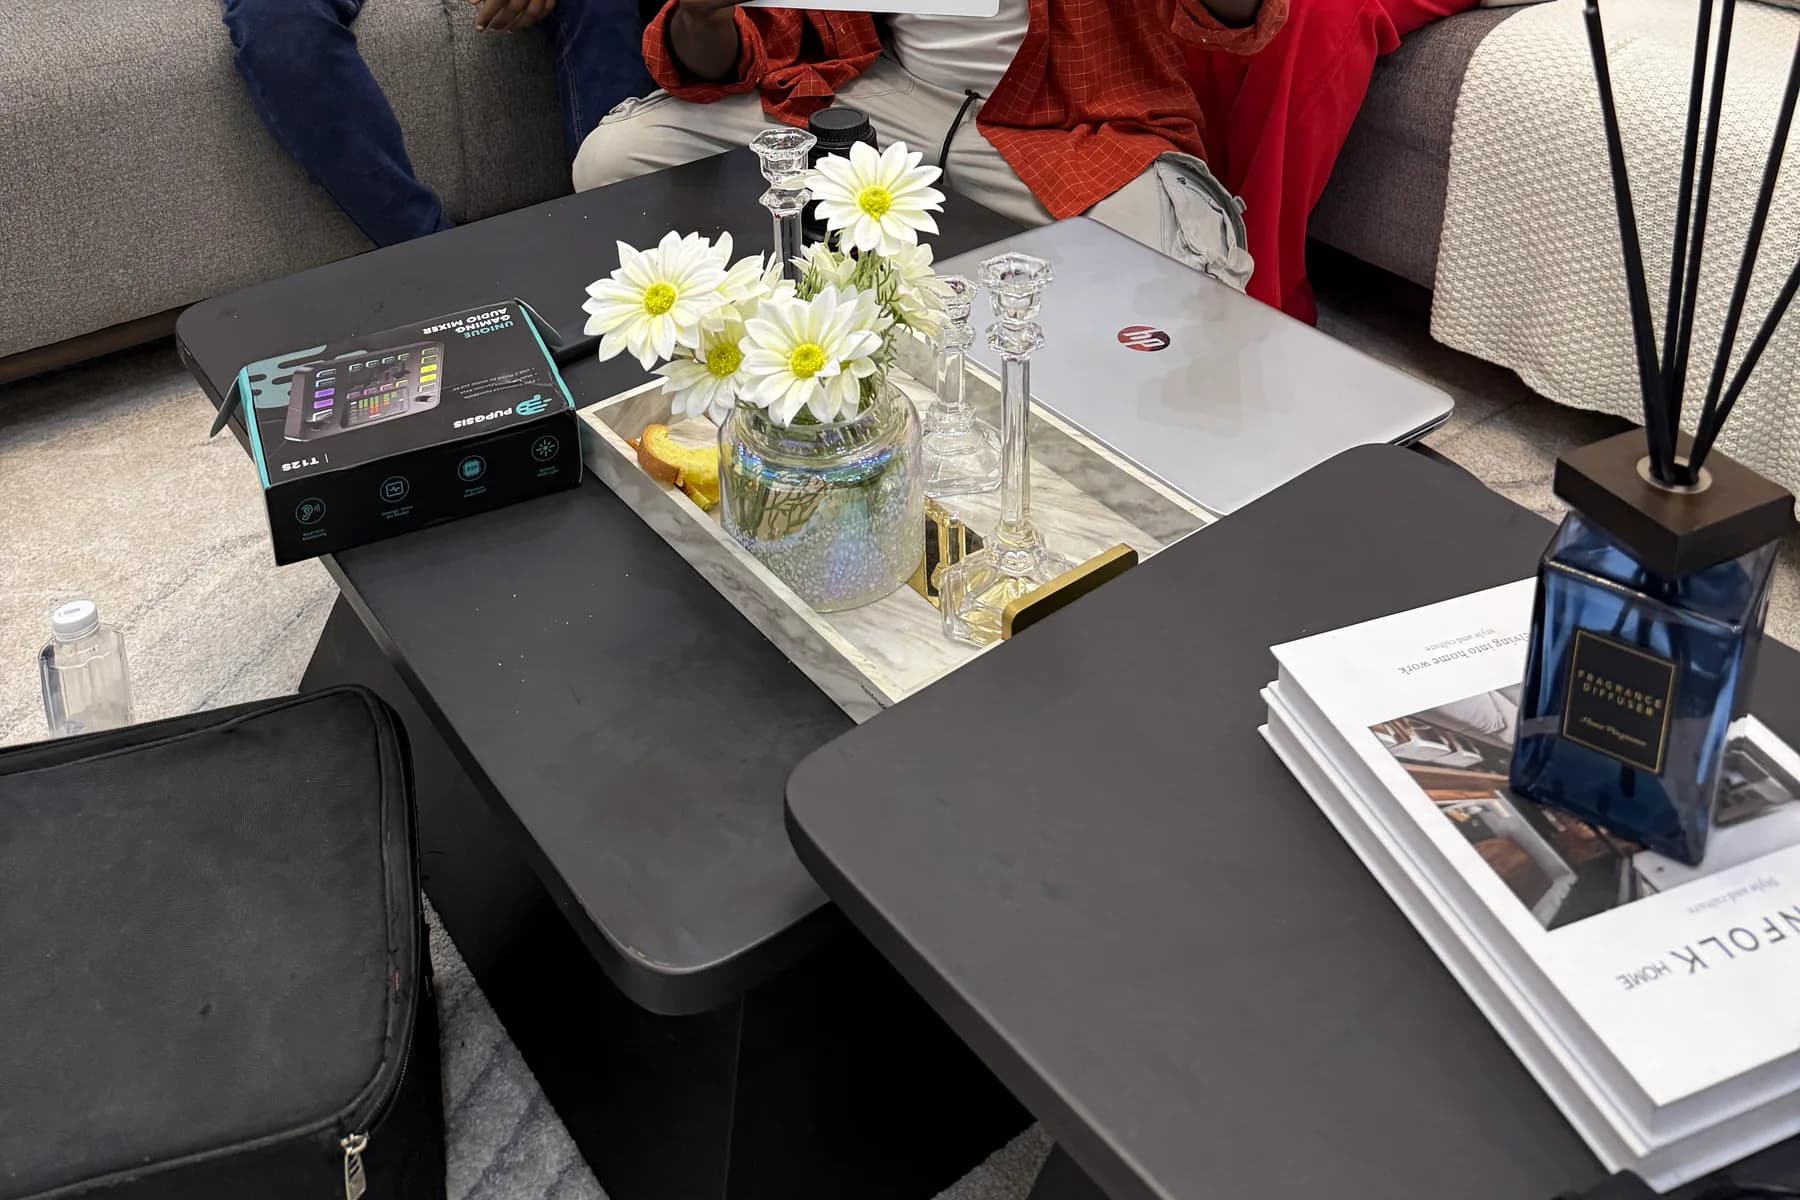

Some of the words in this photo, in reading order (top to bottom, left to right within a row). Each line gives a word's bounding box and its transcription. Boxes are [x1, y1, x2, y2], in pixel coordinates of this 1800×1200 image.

[466, 307, 507, 323] AUDIO
[422, 319, 464, 335] MIXER
[455, 314, 511, 334] GAMING
[463, 320, 514, 339] UNIQUE
[281, 457, 320, 471] T12S
[1491, 632, 1529, 648] elving
[1431, 649, 1470, 665] home
[1467, 643, 1497, 655] into
[1397, 660, 1431, 675] work
[1578, 669, 1662, 709] FRAGRANCE
[1670, 905, 1800, 974] NFOLK
[1616, 960, 1671, 991] HOME
